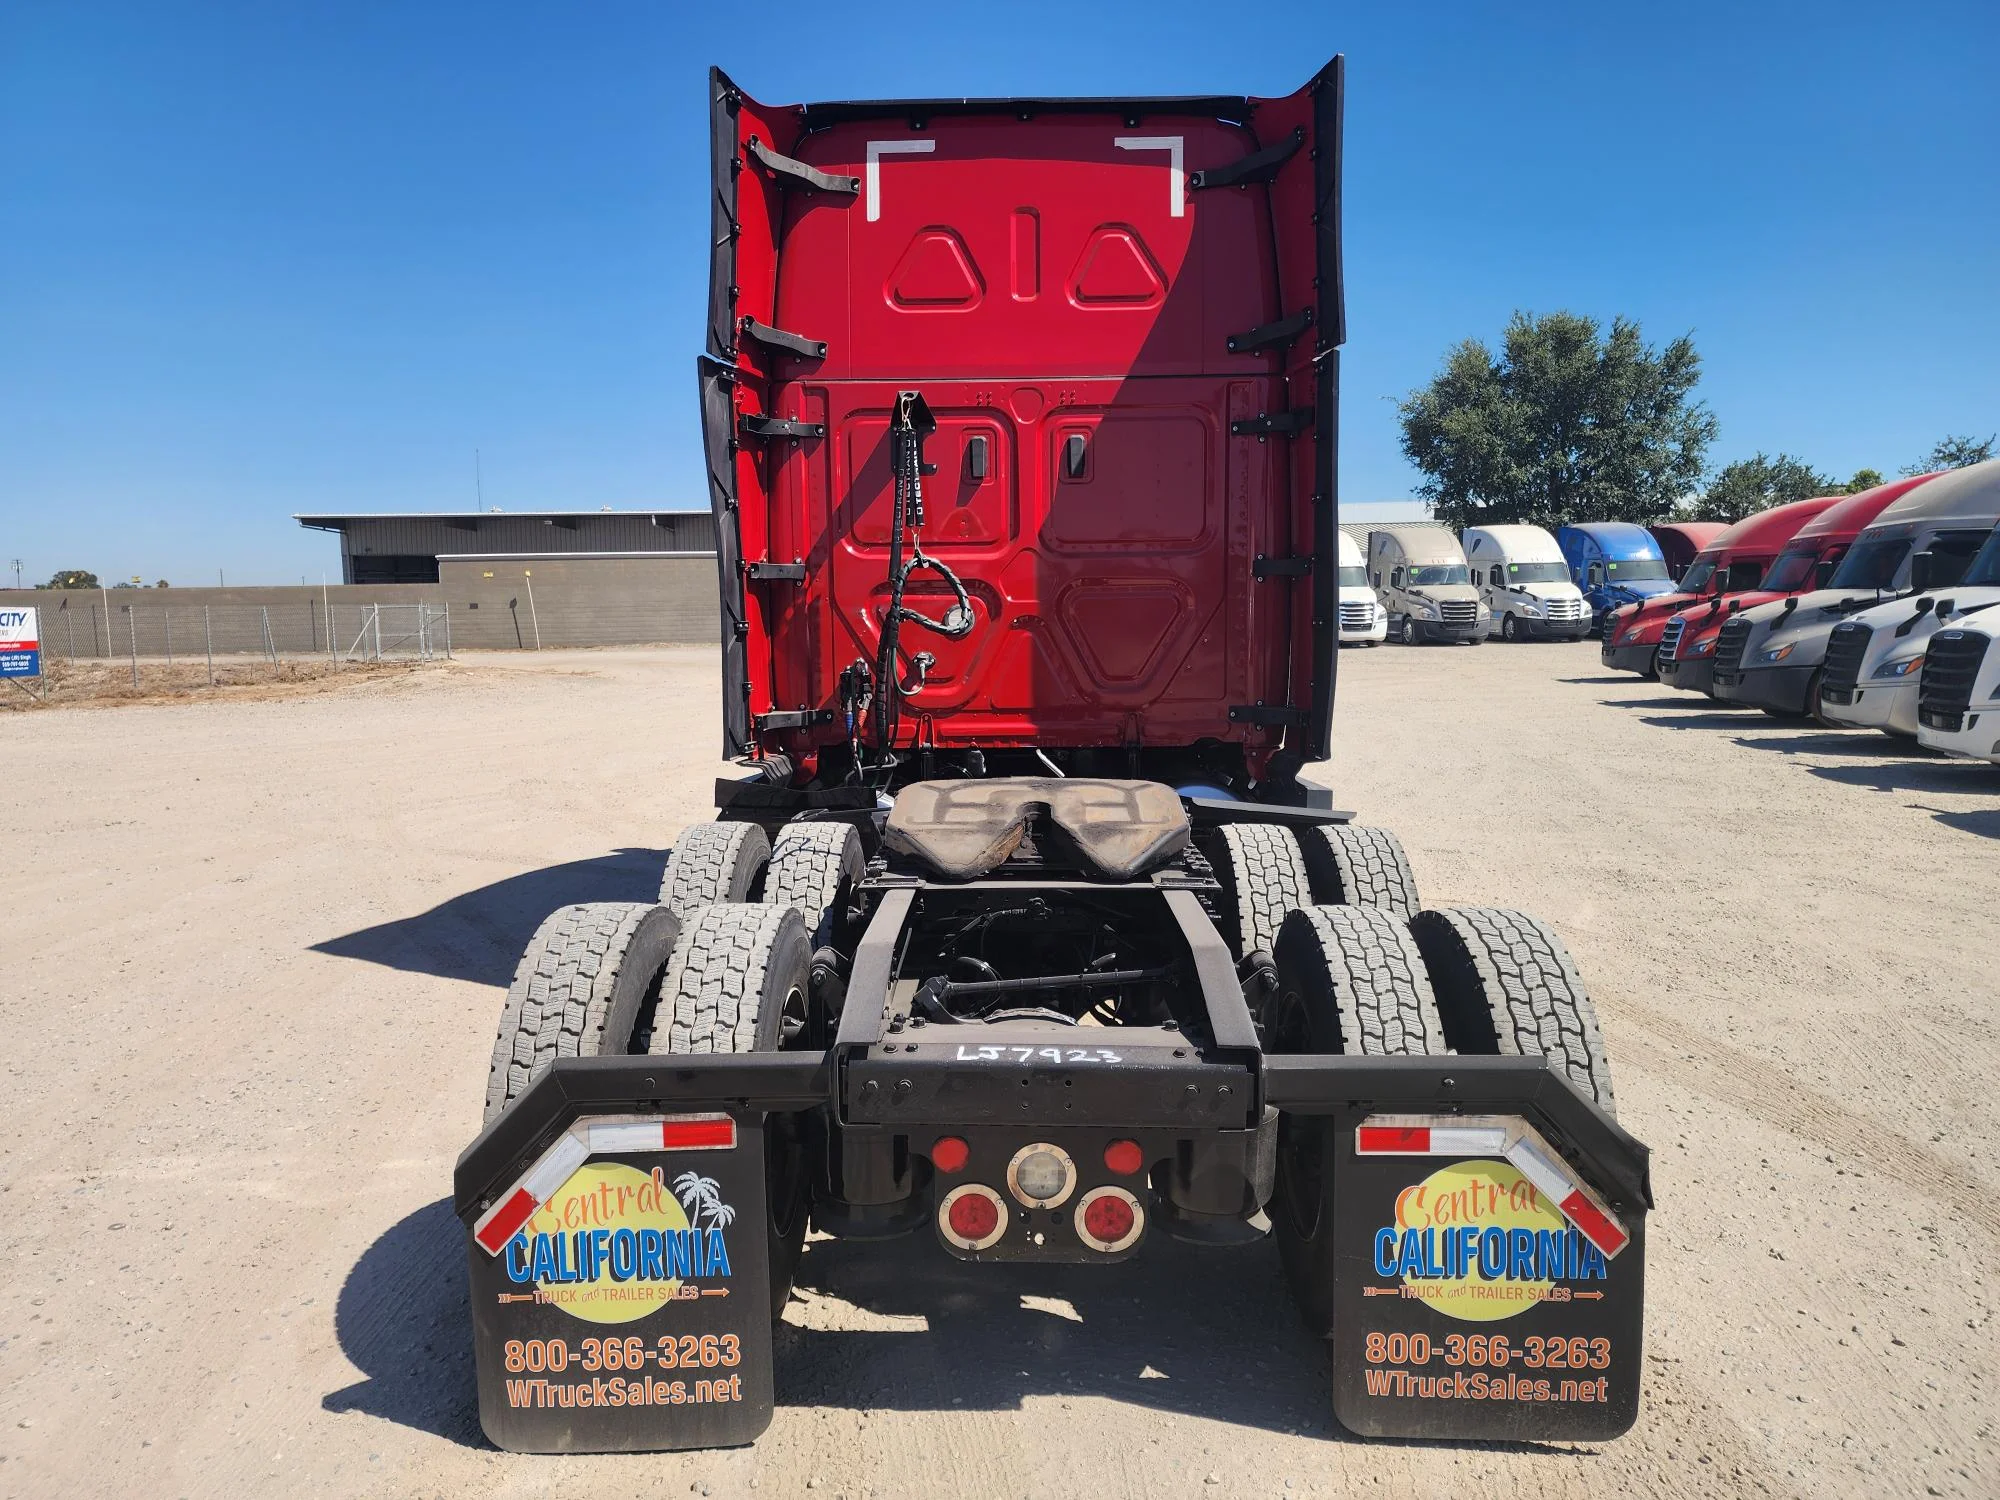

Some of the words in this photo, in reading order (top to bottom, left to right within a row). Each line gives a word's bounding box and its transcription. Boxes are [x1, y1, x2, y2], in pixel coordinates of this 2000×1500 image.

[0, 612, 27, 627] CITY
[505, 1227, 733, 1284] CALIFORNIA
[1374, 1226, 1608, 1280] CALIFORNIA
[532, 1289, 578, 1304] TRUCK
[581, 1285, 600, 1303] and
[602, 1286, 655, 1302] TRAILER
[658, 1285, 700, 1302] SALES
[1399, 1284, 1444, 1300] TRUCK
[1447, 1283, 1467, 1300] and
[1470, 1286, 1524, 1301] TRAILER
[1527, 1286, 1573, 1302] SALES
[504, 1334, 742, 1373] 800-366-3263
[1365, 1332, 1612, 1369] 800-366-3263
[505, 1374, 743, 1408] WTruckSales.net
[1365, 1369, 1609, 1403] WTruckSales.net
